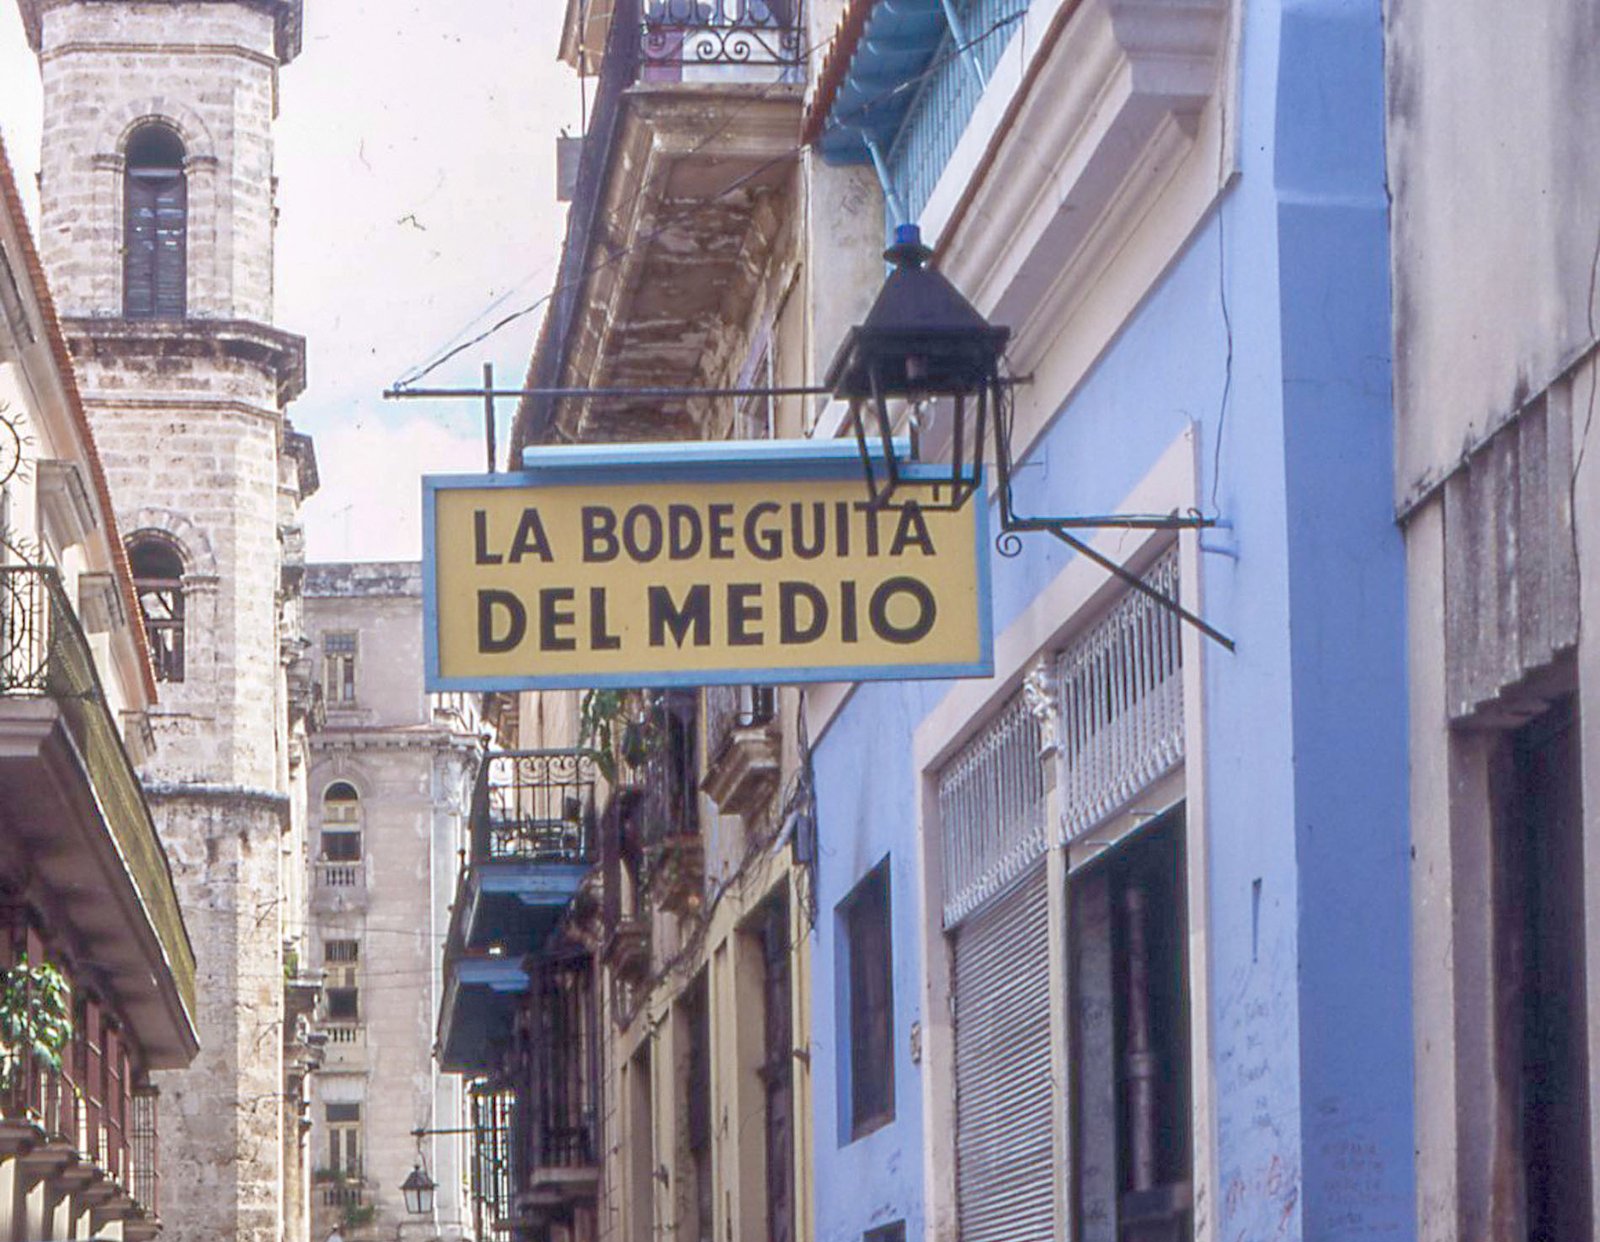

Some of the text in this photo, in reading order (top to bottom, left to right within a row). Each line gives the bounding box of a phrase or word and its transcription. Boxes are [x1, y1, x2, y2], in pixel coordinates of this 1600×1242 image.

[474, 501, 937, 565] LA BODEGUITA
[477, 575, 938, 654] DEL MEDIO
